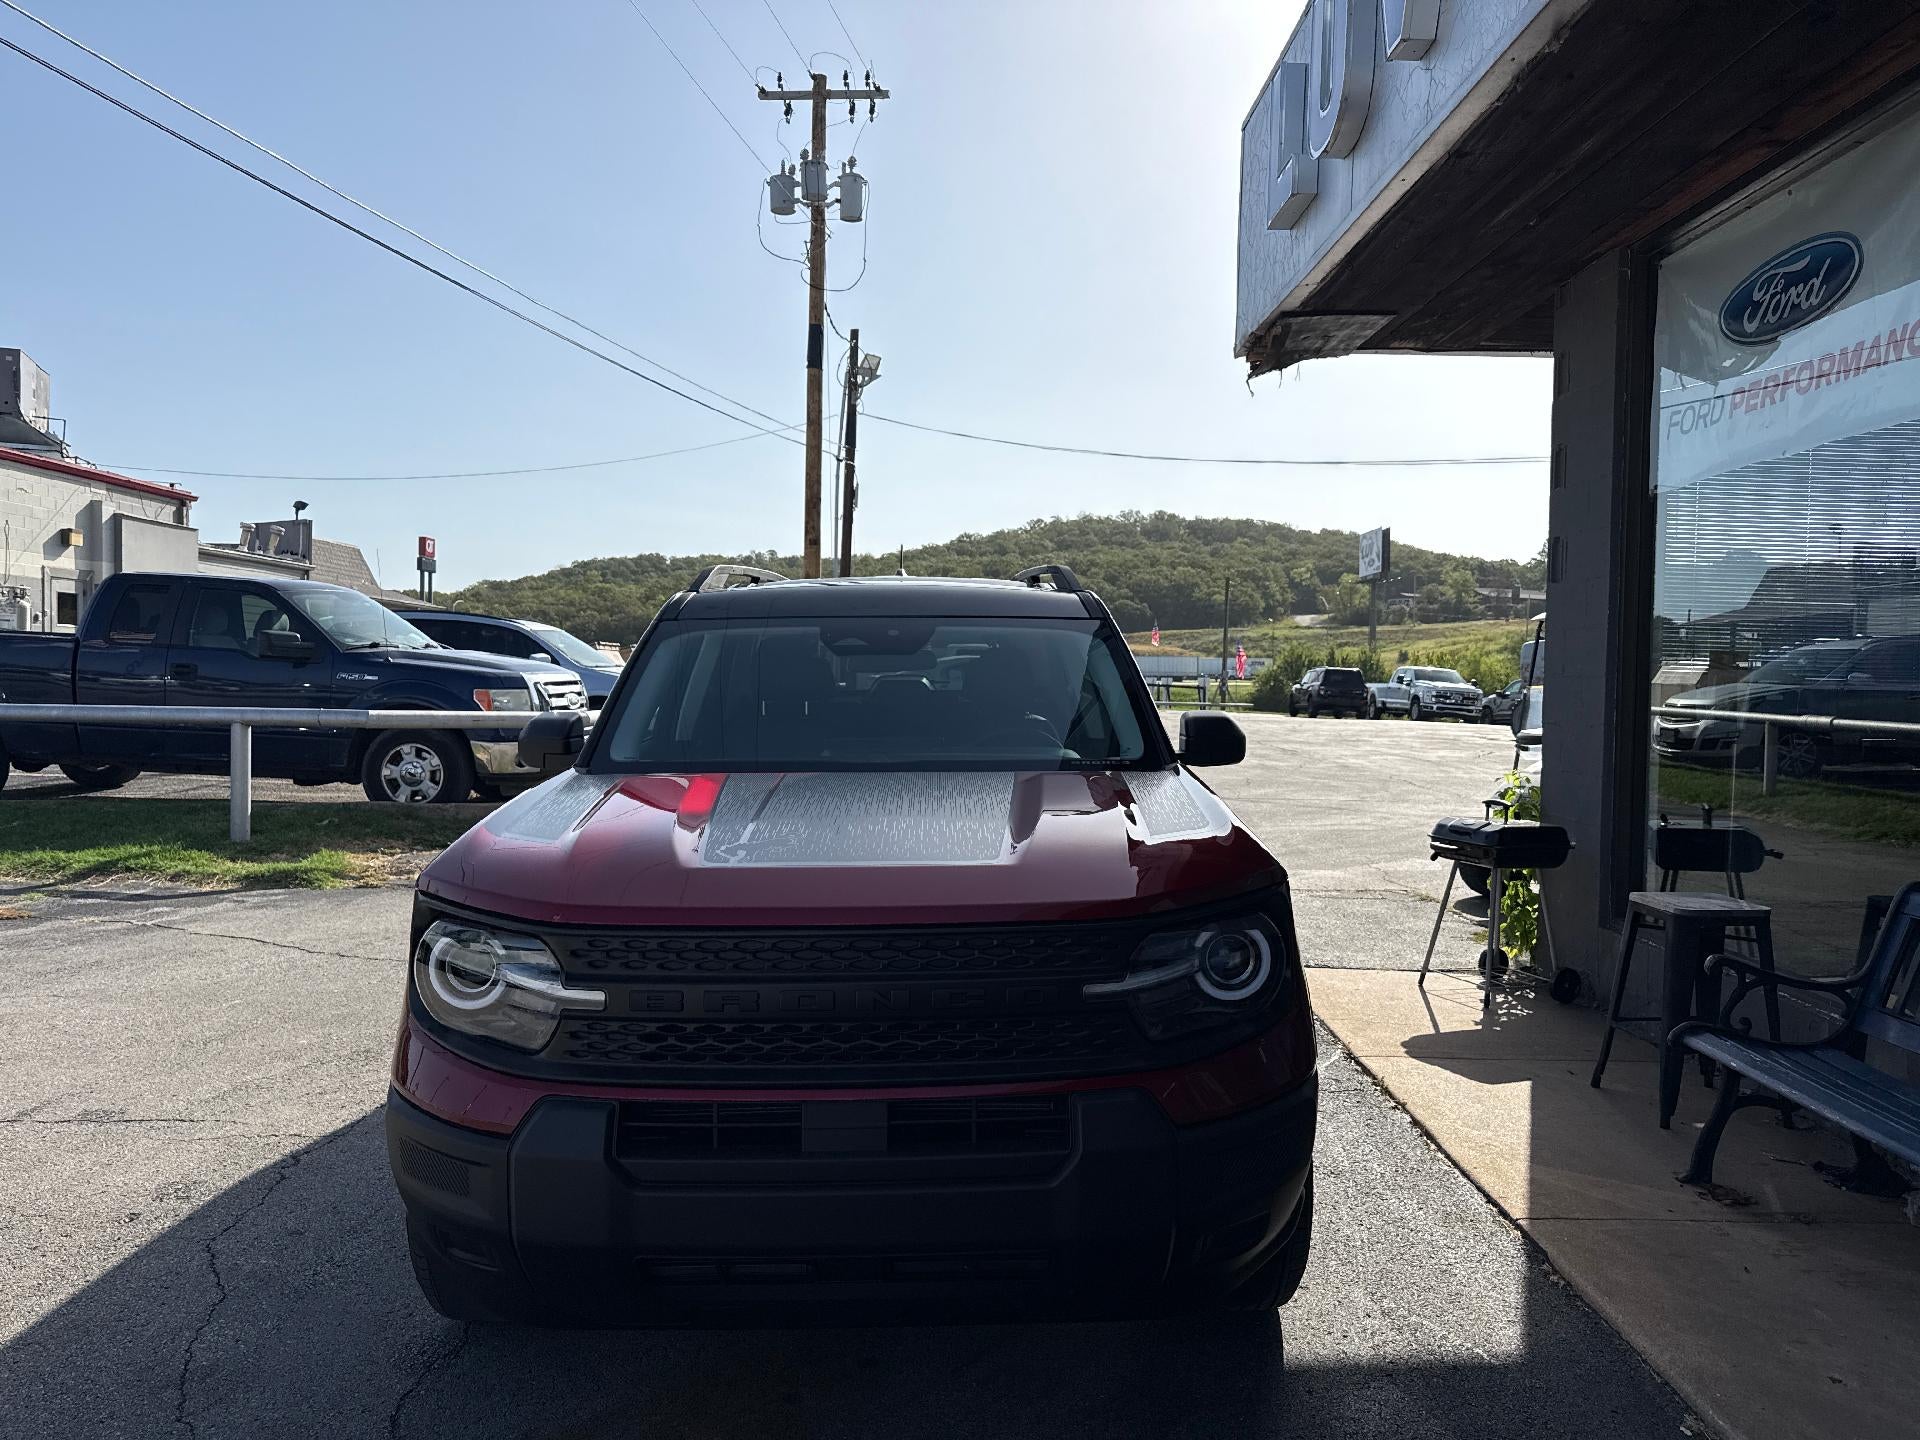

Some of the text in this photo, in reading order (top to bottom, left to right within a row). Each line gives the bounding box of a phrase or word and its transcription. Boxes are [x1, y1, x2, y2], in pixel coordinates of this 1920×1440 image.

[1266, 0, 1442, 230] LU
[1742, 254, 1832, 333] Ford
[1666, 396, 1726, 440] FORD
[630, 987, 1058, 1012] BRONCO
